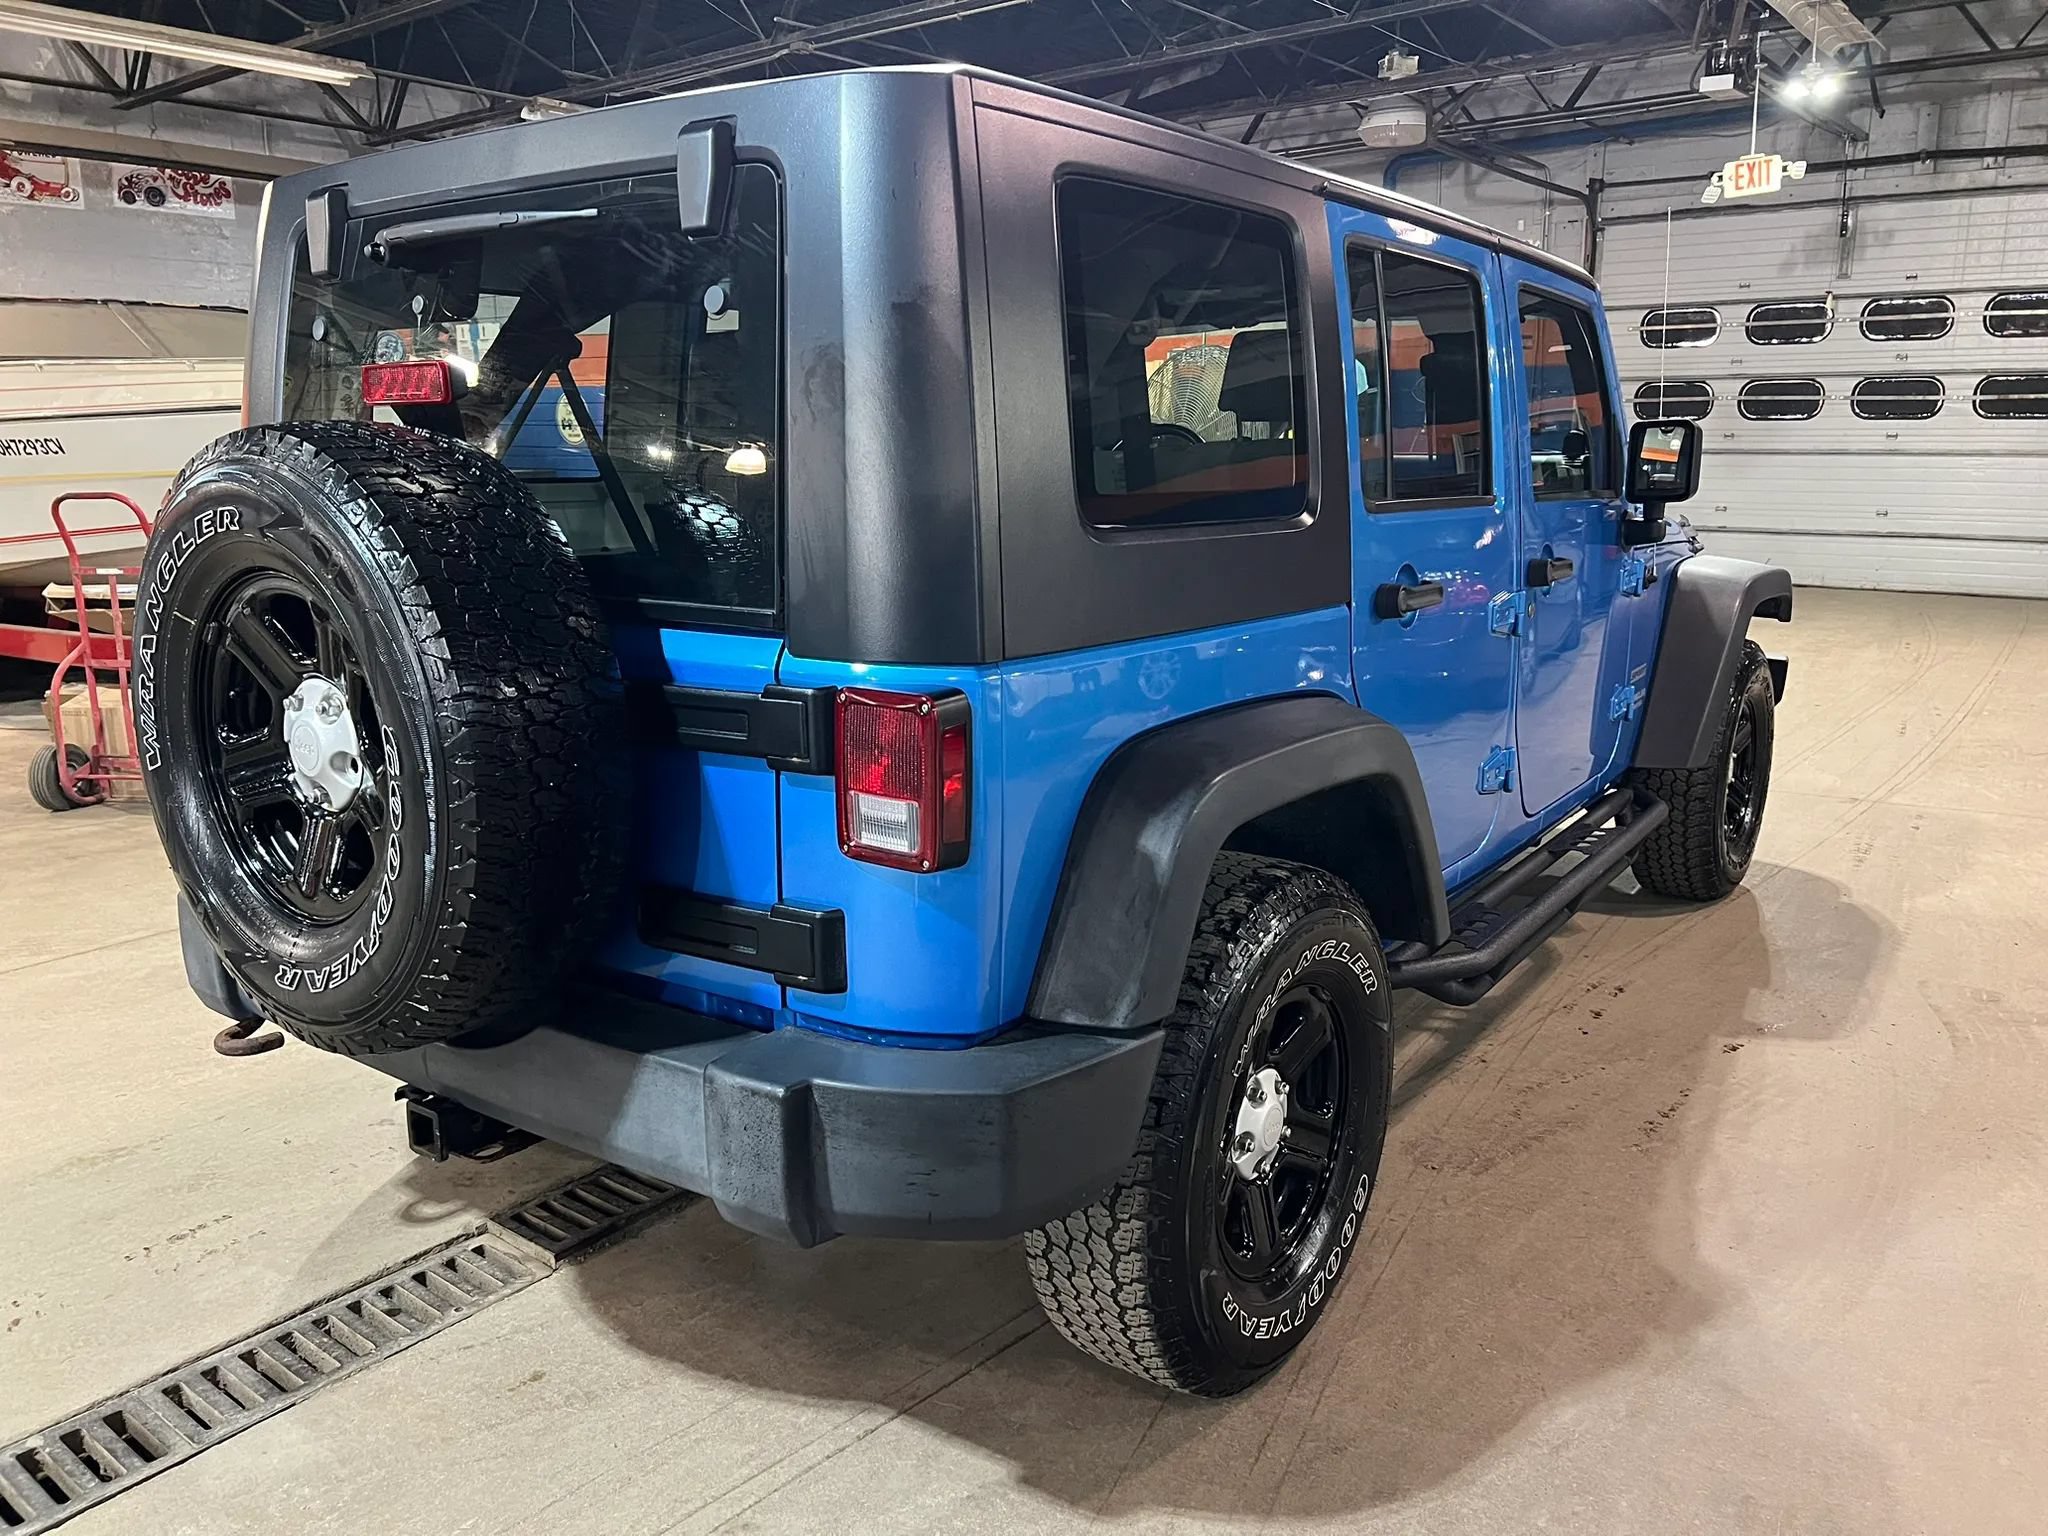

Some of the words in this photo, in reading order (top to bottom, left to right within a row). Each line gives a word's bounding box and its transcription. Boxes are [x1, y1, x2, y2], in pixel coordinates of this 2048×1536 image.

[1735, 159, 1773, 190] EXIT
[139, 506, 240, 771] WRANGLER
[275, 724, 402, 992] GOODYEAR
[1232, 940, 1378, 1077] WRANGLER
[1223, 1174, 1368, 1339] GOODYEAR
